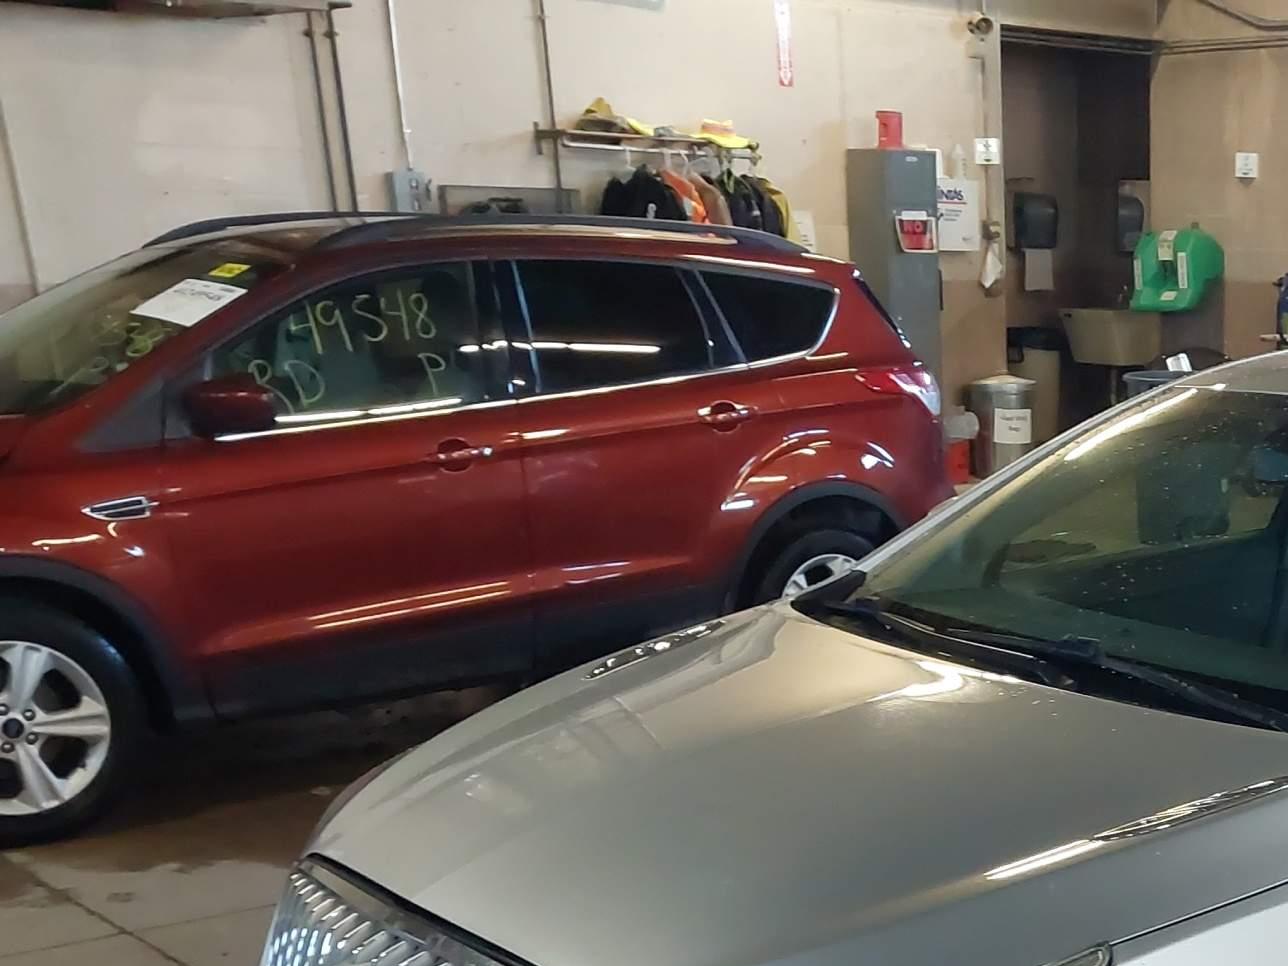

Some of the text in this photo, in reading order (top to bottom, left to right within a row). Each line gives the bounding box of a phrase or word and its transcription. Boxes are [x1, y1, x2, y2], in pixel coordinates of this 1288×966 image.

[937, 186, 964, 201] INTAS
[289, 288, 437, 355] 49548
[418, 352, 446, 397] P
